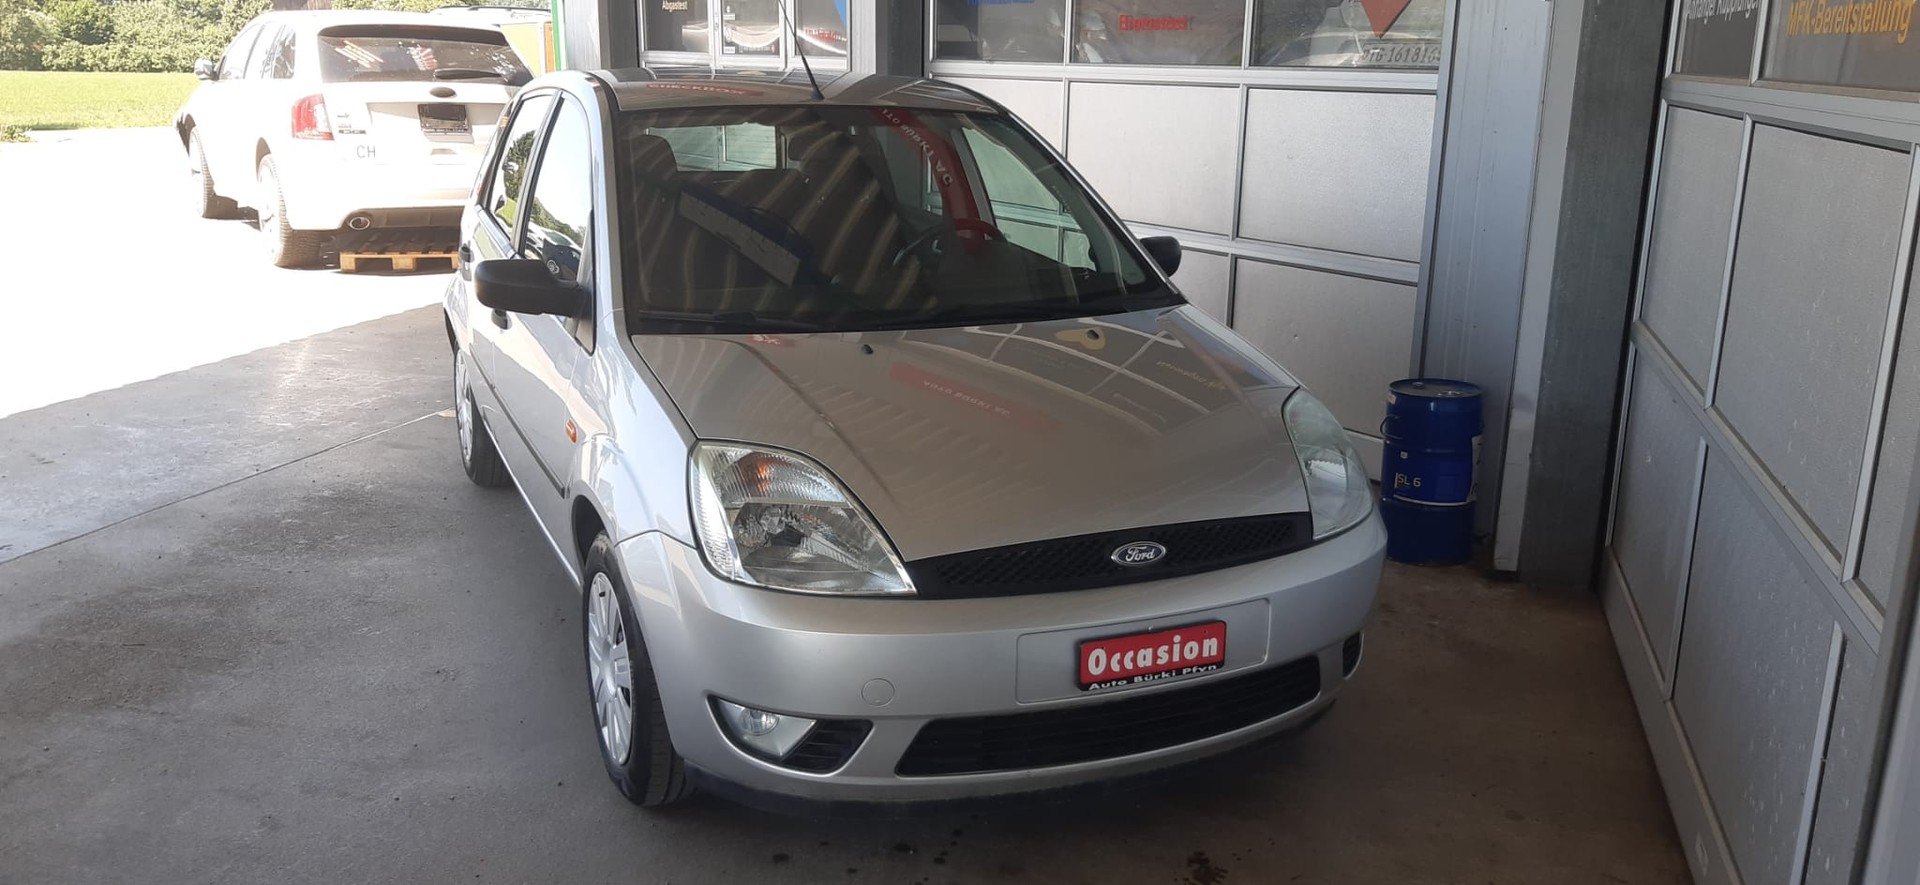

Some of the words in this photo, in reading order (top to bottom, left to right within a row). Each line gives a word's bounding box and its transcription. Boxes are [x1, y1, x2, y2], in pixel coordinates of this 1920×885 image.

[357, 144, 376, 159] CH
[1125, 545, 1156, 562] Ford
[1087, 634, 1218, 676] Occasion
[1088, 680, 1128, 691] Auto
[1133, 670, 1177, 683] Bürki
